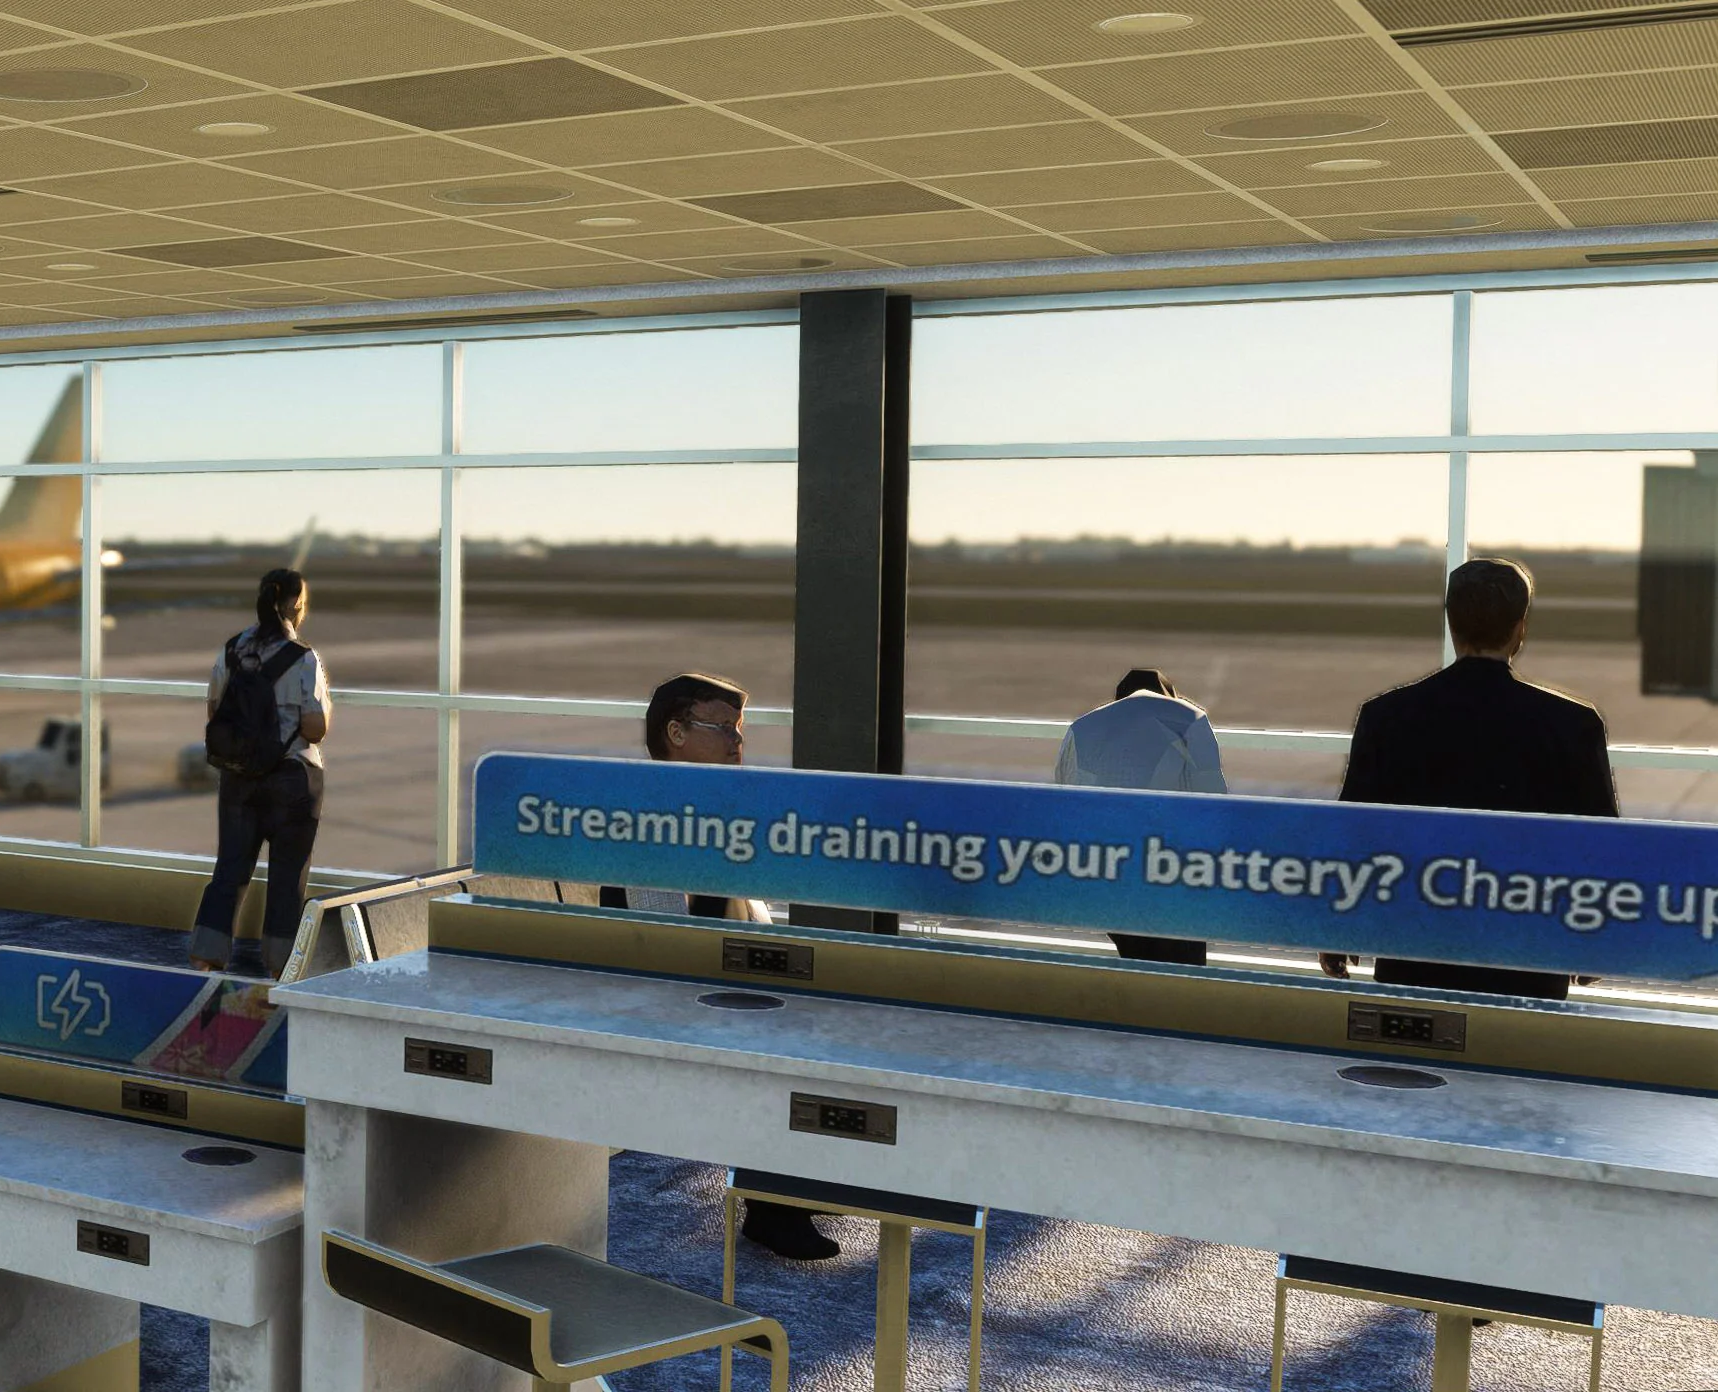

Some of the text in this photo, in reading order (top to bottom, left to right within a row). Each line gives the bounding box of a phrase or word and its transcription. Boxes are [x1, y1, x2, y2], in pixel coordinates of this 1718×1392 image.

[517, 795, 756, 862] Streaming
[768, 812, 986, 880] draining
[998, 836, 1131, 884] your
[1145, 837, 1404, 911] battery?
[1422, 858, 1644, 931] Charge
